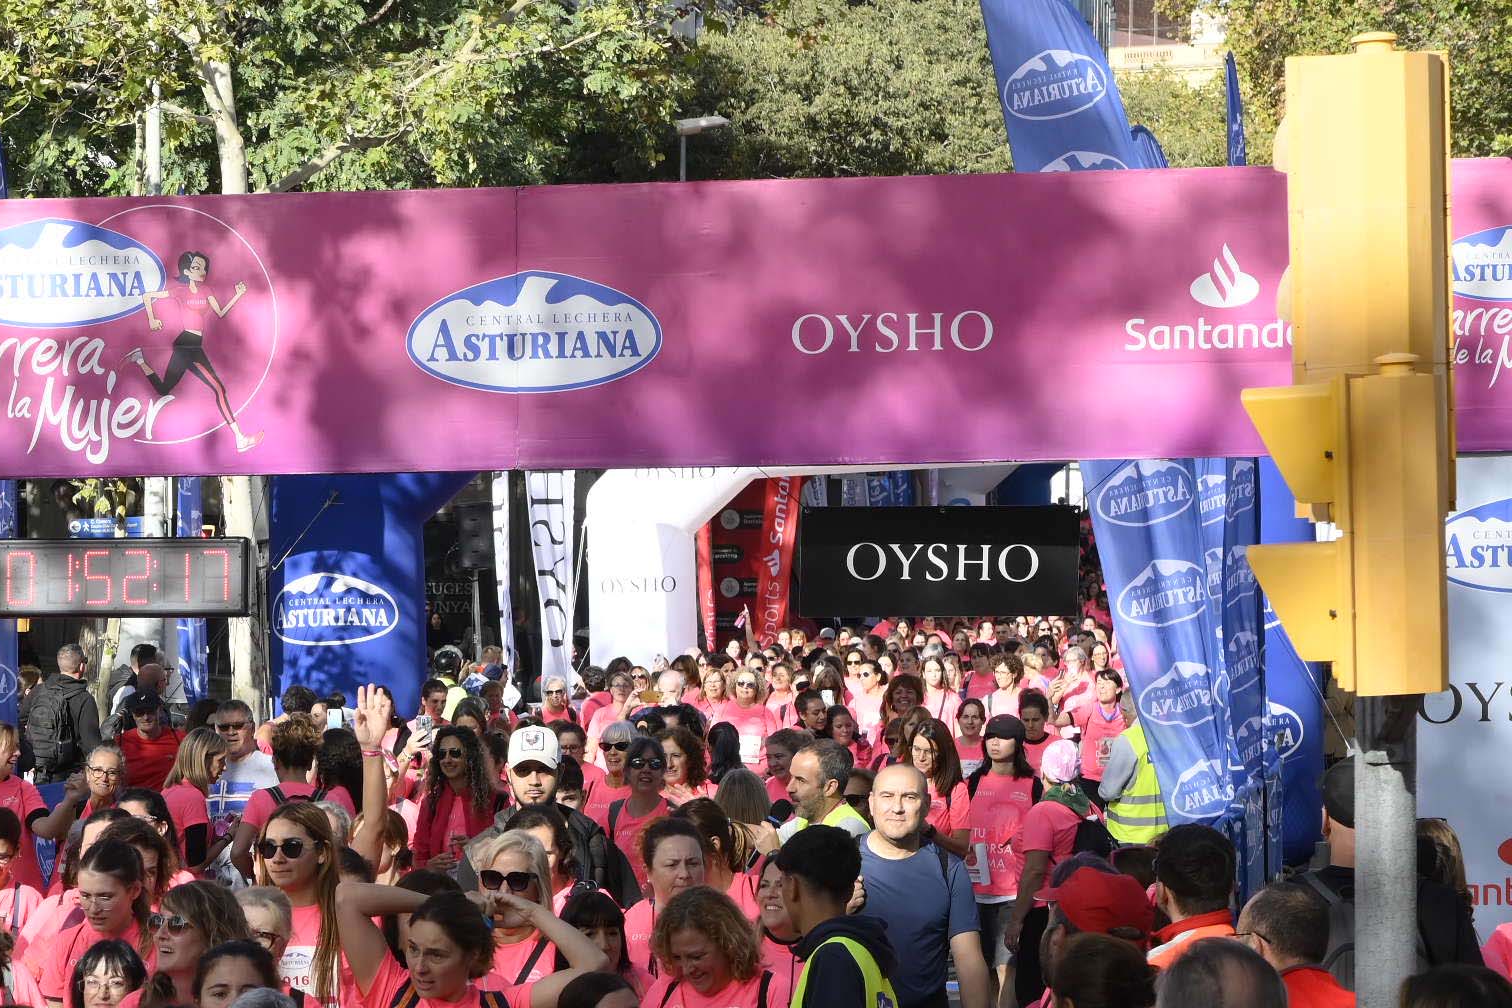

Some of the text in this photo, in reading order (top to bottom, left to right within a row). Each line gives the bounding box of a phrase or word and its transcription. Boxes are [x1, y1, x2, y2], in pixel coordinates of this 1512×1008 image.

[466, 311, 634, 326] CENTRAL LECHERA
[792, 310, 994, 355] OYSHO
[426, 317, 641, 363] ASTURIANA
[1476, 337, 1492, 364] la
[7, 379, 31, 419] la
[27, 370, 176, 465] Mujer
[846, 542, 1041, 583] OYSHO
[601, 575, 678, 594] OYSHO
[277, 602, 390, 629] ASTURIANA
